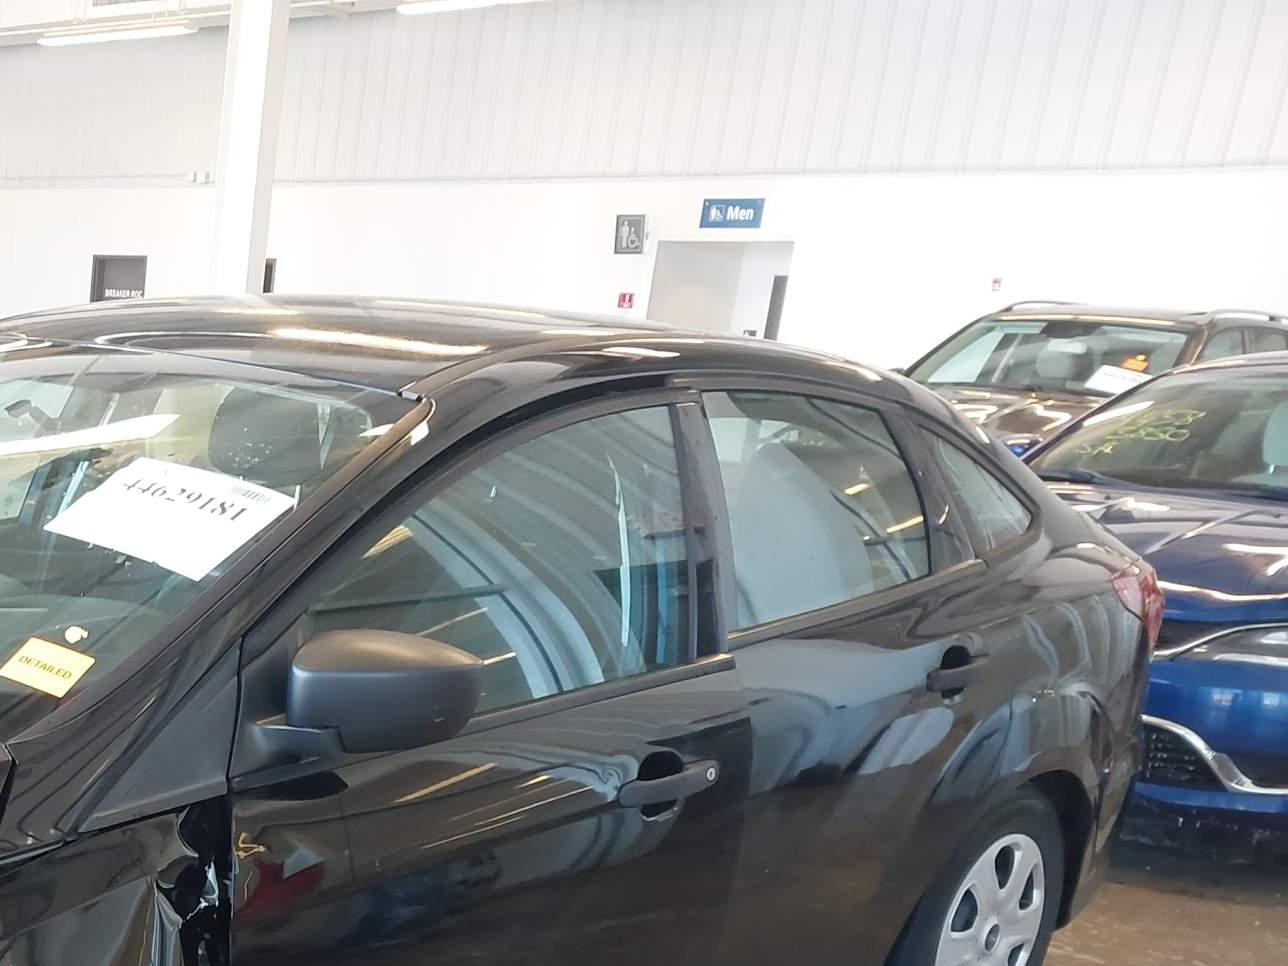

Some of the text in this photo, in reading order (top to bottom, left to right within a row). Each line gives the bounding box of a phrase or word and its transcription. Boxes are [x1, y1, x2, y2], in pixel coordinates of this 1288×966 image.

[726, 206, 754, 221] Men
[105, 288, 130, 298] BREAKER
[123, 478, 248, 521] 44629181
[18, 655, 73, 680] DETAILED
